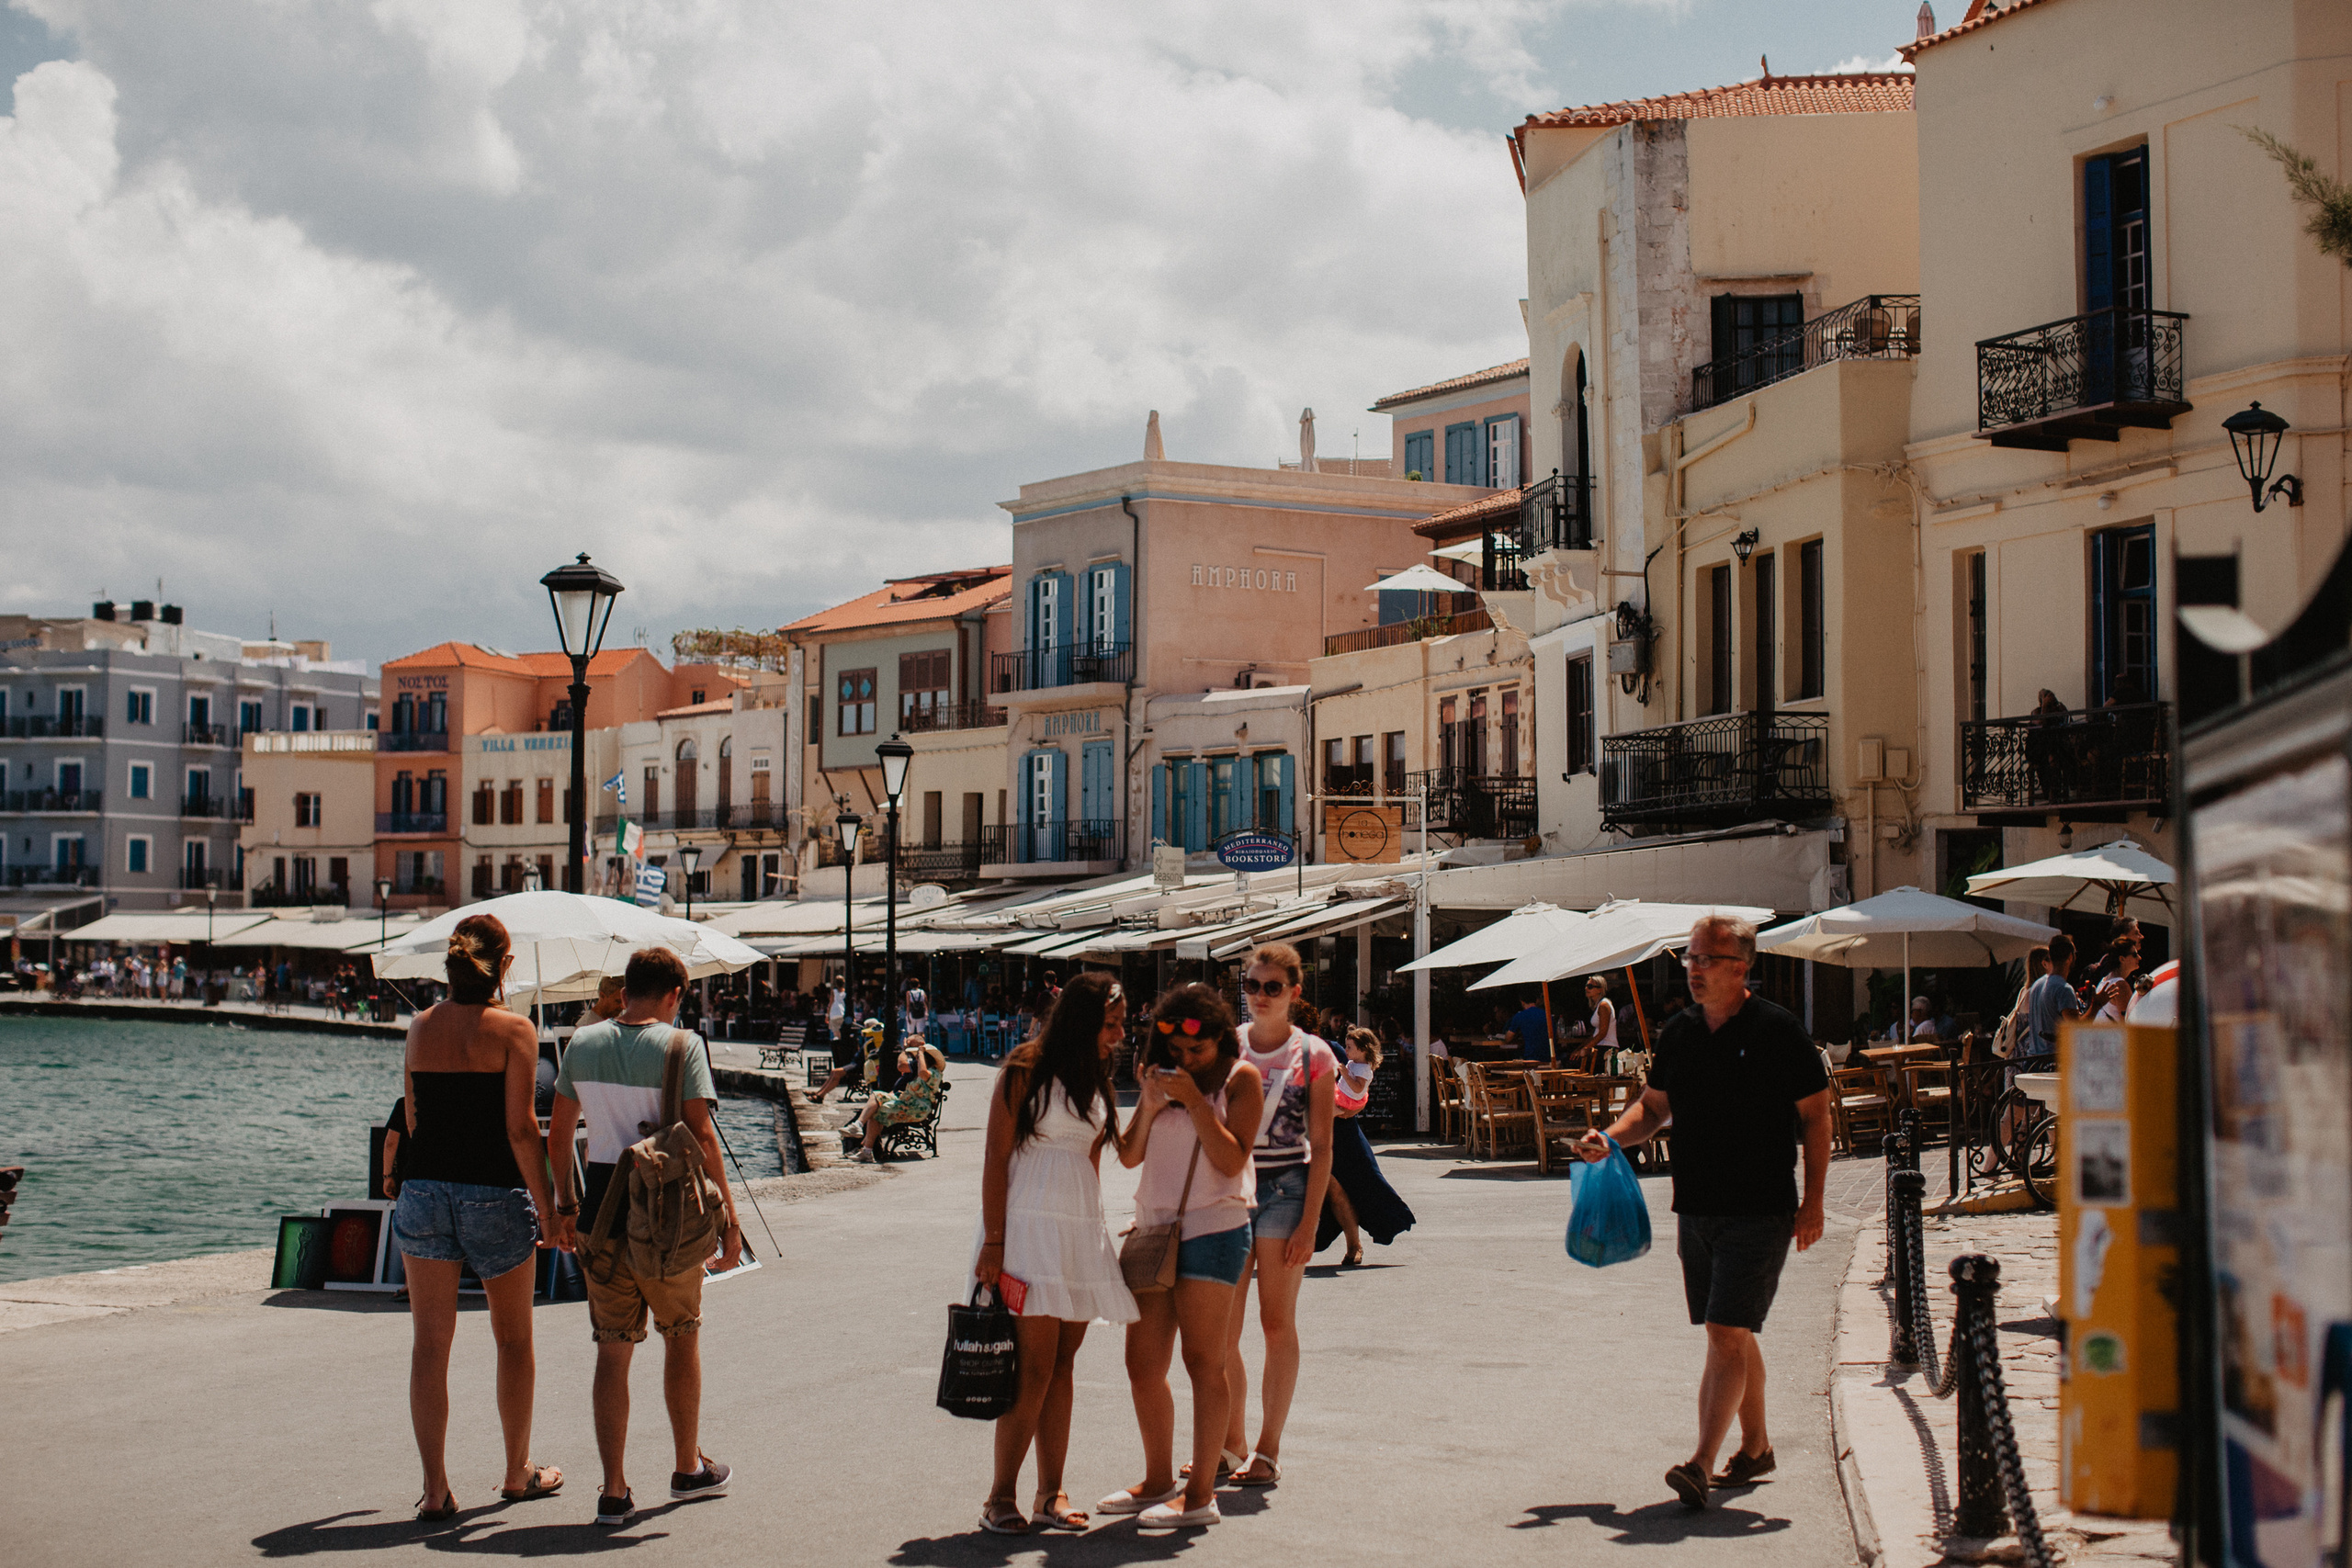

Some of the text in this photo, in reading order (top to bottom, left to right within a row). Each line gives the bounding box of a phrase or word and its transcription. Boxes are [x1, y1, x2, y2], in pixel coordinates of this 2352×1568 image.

[1191, 564, 1297, 592] AMPHORA
[398, 675, 449, 688] ΝΟΣΤΟΣ
[1045, 711, 1101, 736] AMPHORA
[481, 736, 573, 752] VILLA VENEZI
[1224, 838, 1289, 852] MEDITERRANEO
[1225, 854, 1287, 863] BOOKSTORE
[1154, 872, 1183, 882] seasons
